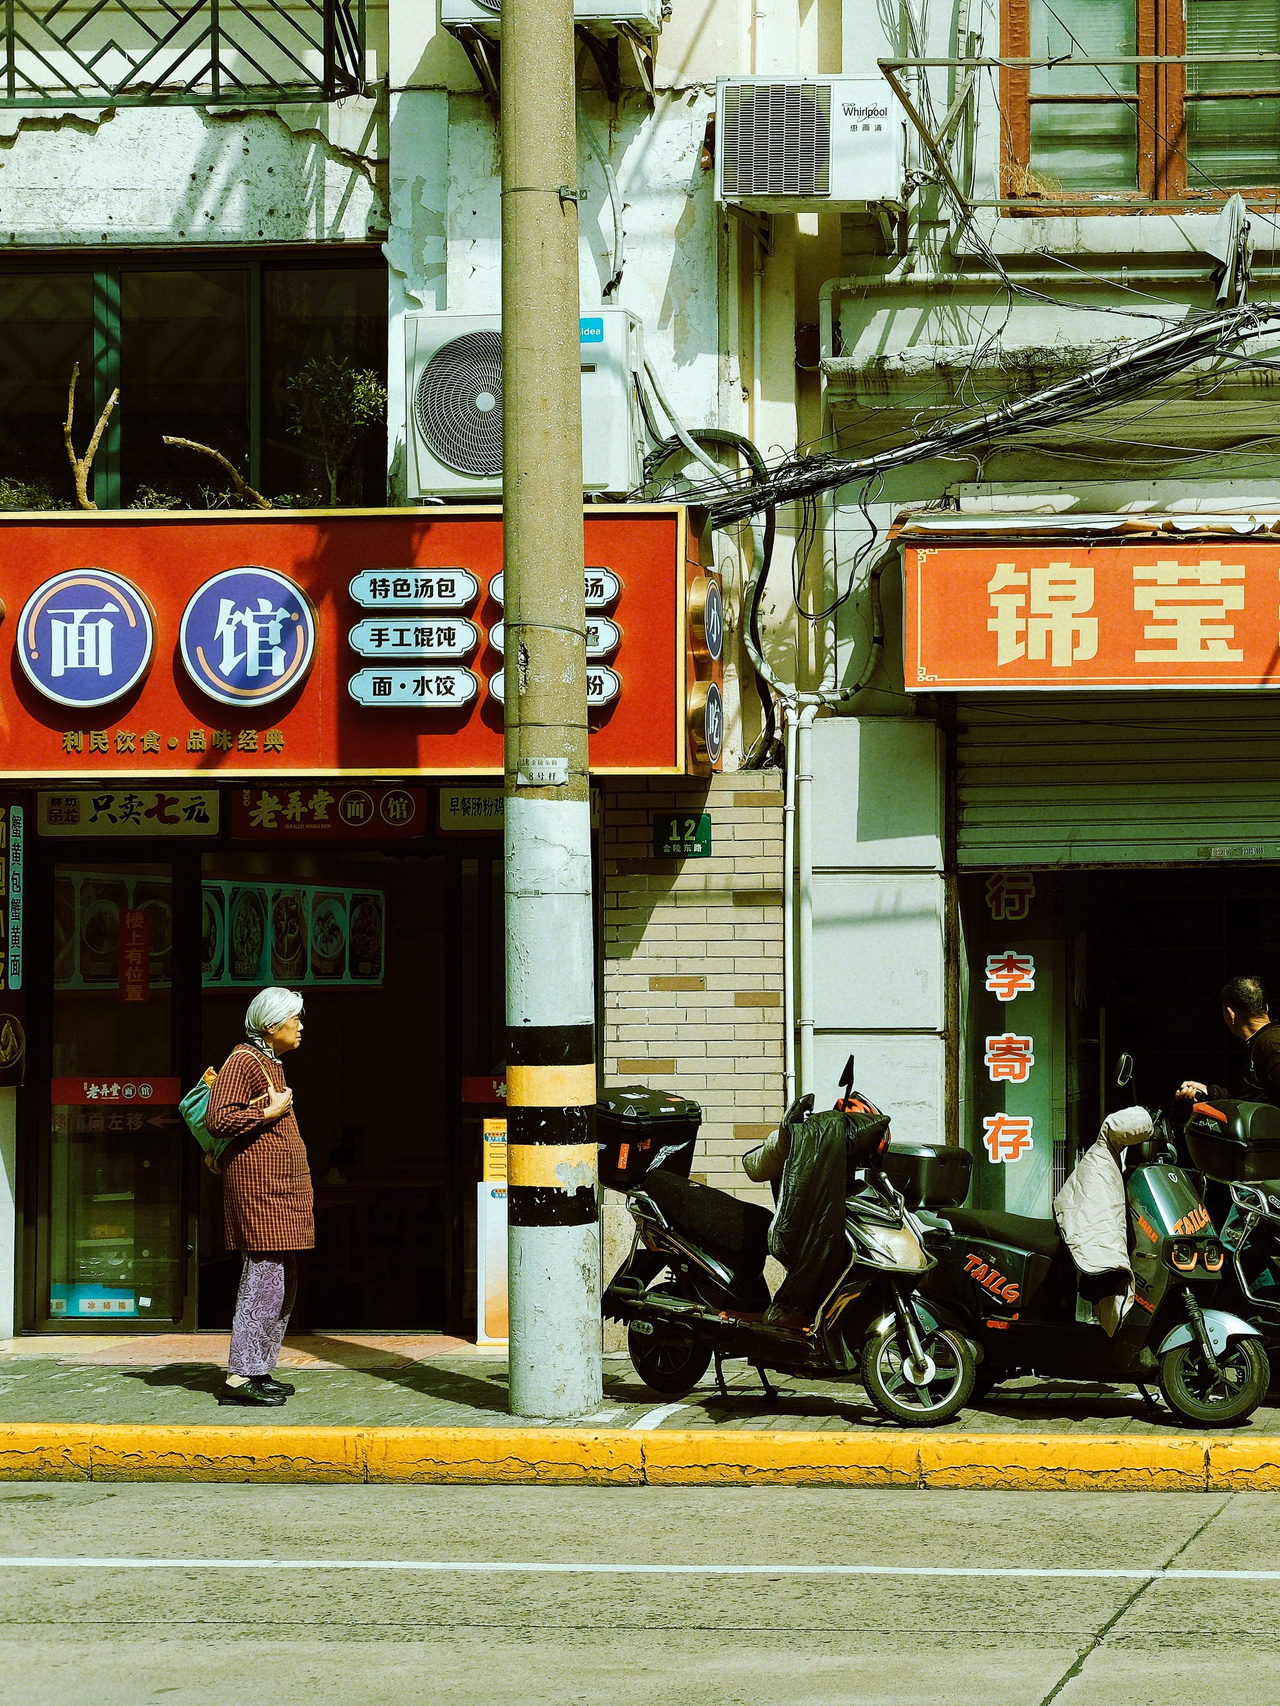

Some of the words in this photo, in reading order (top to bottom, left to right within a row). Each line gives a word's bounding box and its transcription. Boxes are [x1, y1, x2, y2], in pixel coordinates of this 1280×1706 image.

[843, 107, 888, 119] Whirlpool
[580, 328, 601, 336] idea
[369, 578, 456, 599] 特色汤包
[369, 627, 456, 648] 手工馄饨
[88, 793, 211, 826] 只卖七元
[669, 819, 696, 841] 12
[663, 843, 703, 853] 金陵东路
[125, 911, 144, 1000] 楼上有位置
[982, 872, 1035, 1163] 行李寄存
[1173, 1203, 1211, 1235] TAILG
[963, 1253, 1020, 1303] TAILG
